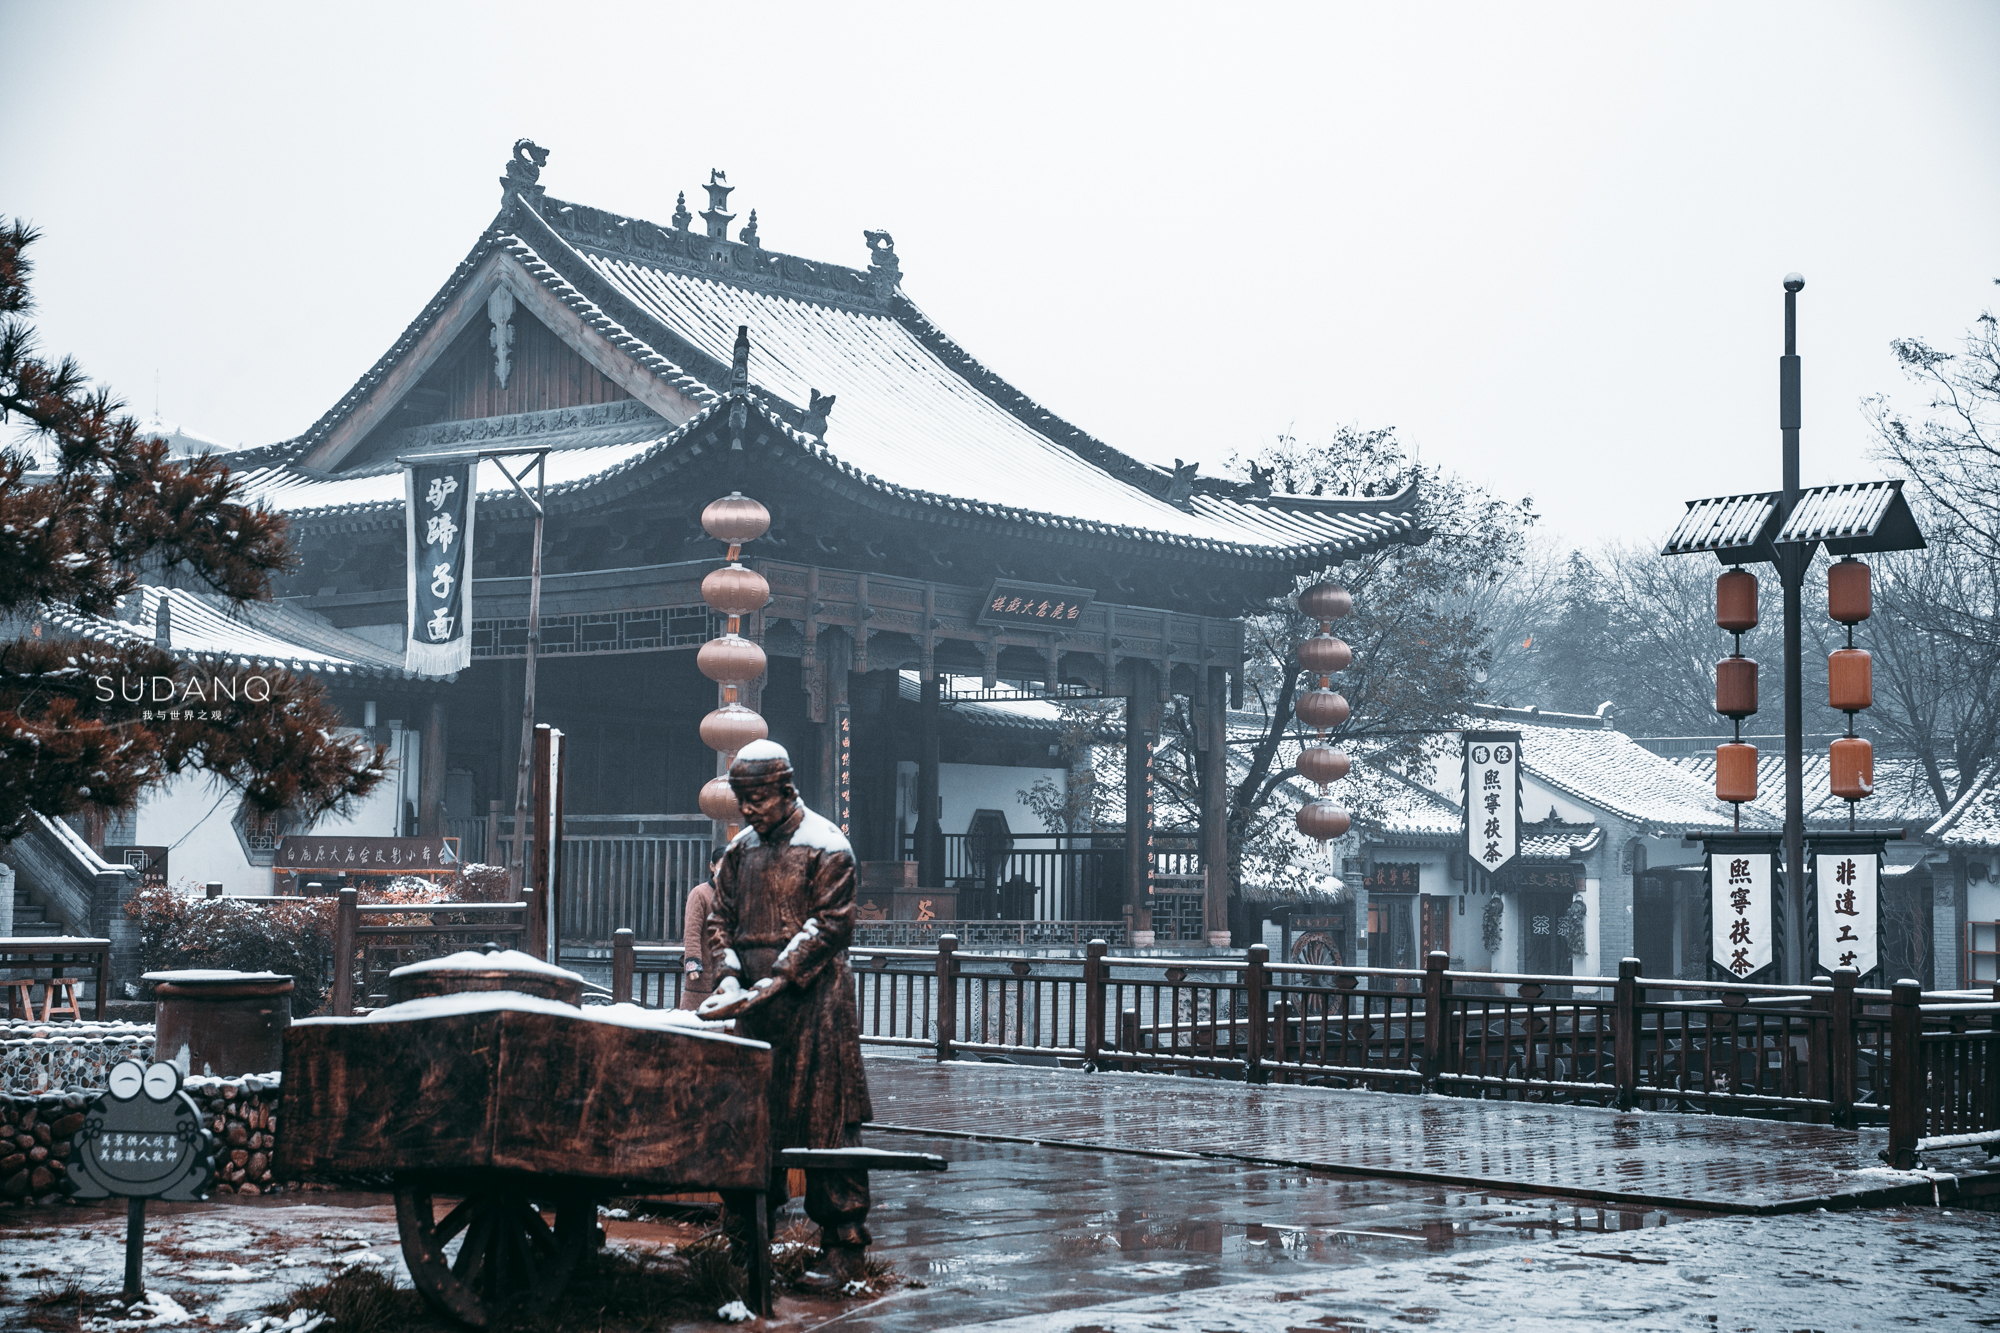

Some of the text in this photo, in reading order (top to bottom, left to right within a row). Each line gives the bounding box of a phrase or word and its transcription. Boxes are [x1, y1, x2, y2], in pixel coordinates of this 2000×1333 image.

[425, 475, 459, 640] 驴蹄子面
[1533, 915, 1550, 935] 茶
